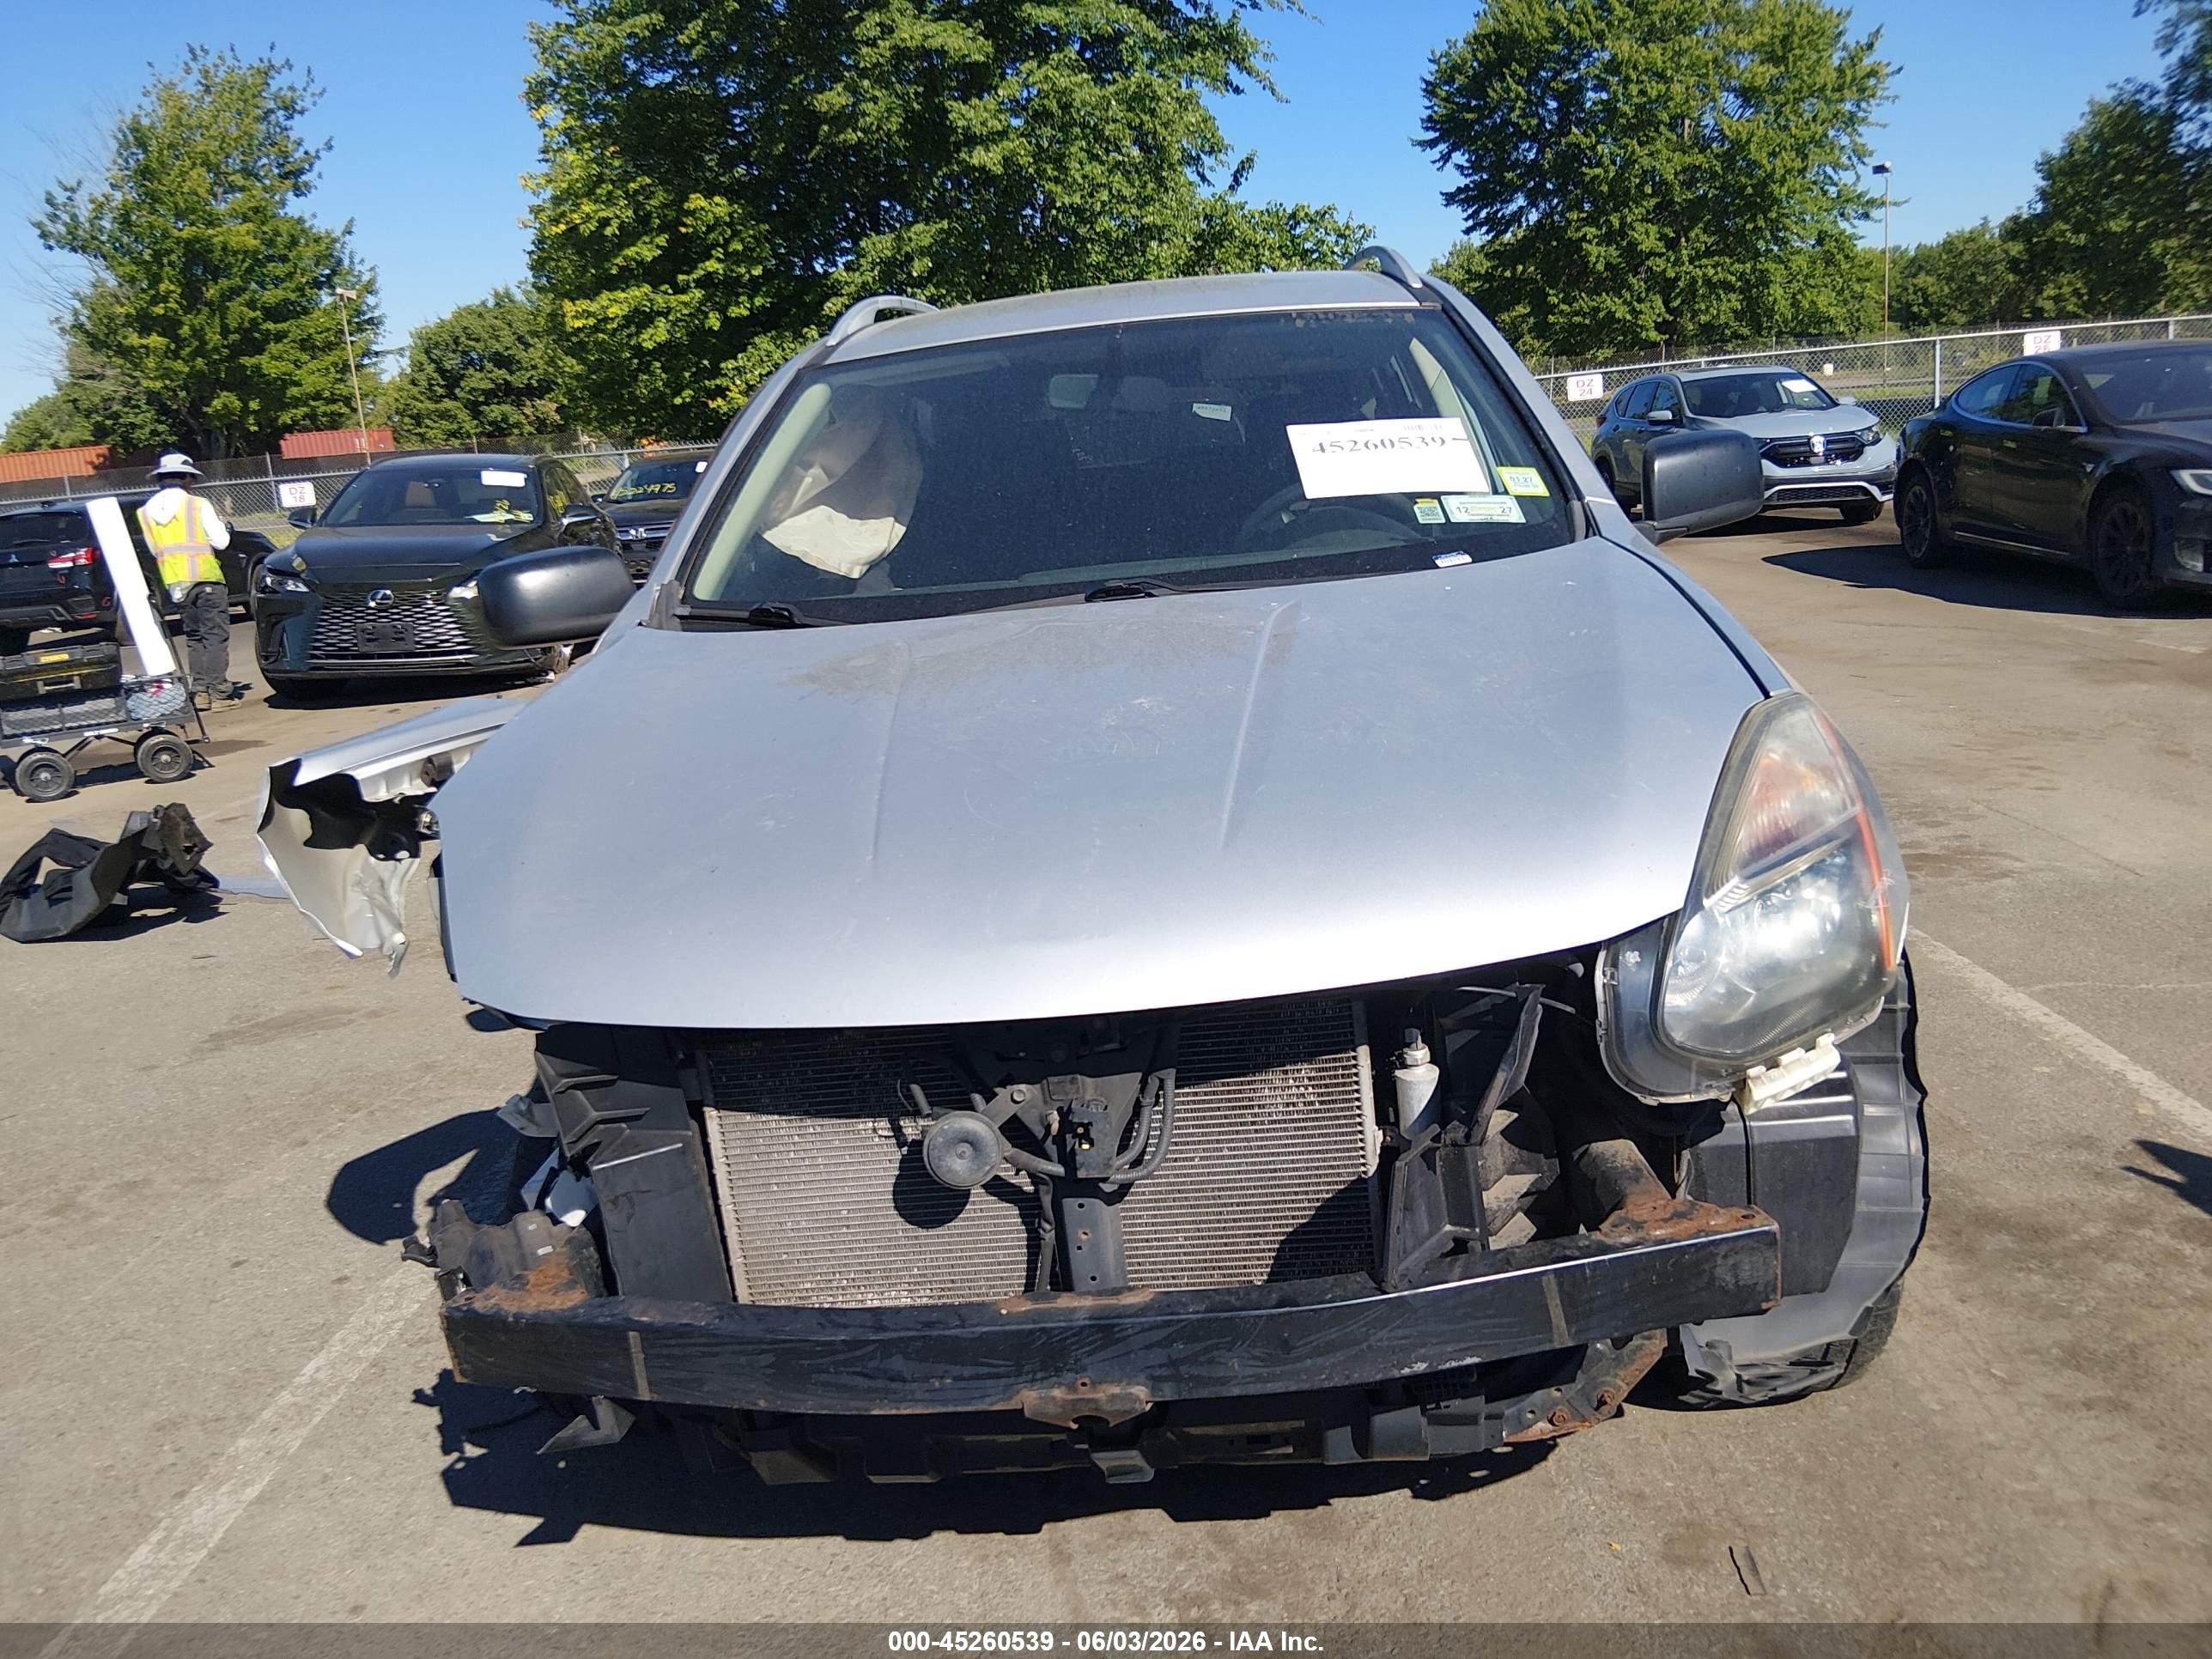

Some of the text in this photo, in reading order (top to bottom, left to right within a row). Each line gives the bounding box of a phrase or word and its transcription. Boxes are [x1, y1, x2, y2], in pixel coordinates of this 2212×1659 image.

[2033, 335, 2051, 344] DZ
[1576, 379, 1594, 388] DZ
[289, 486, 307, 495] DZ
[1455, 506, 1513, 514] 12 27
